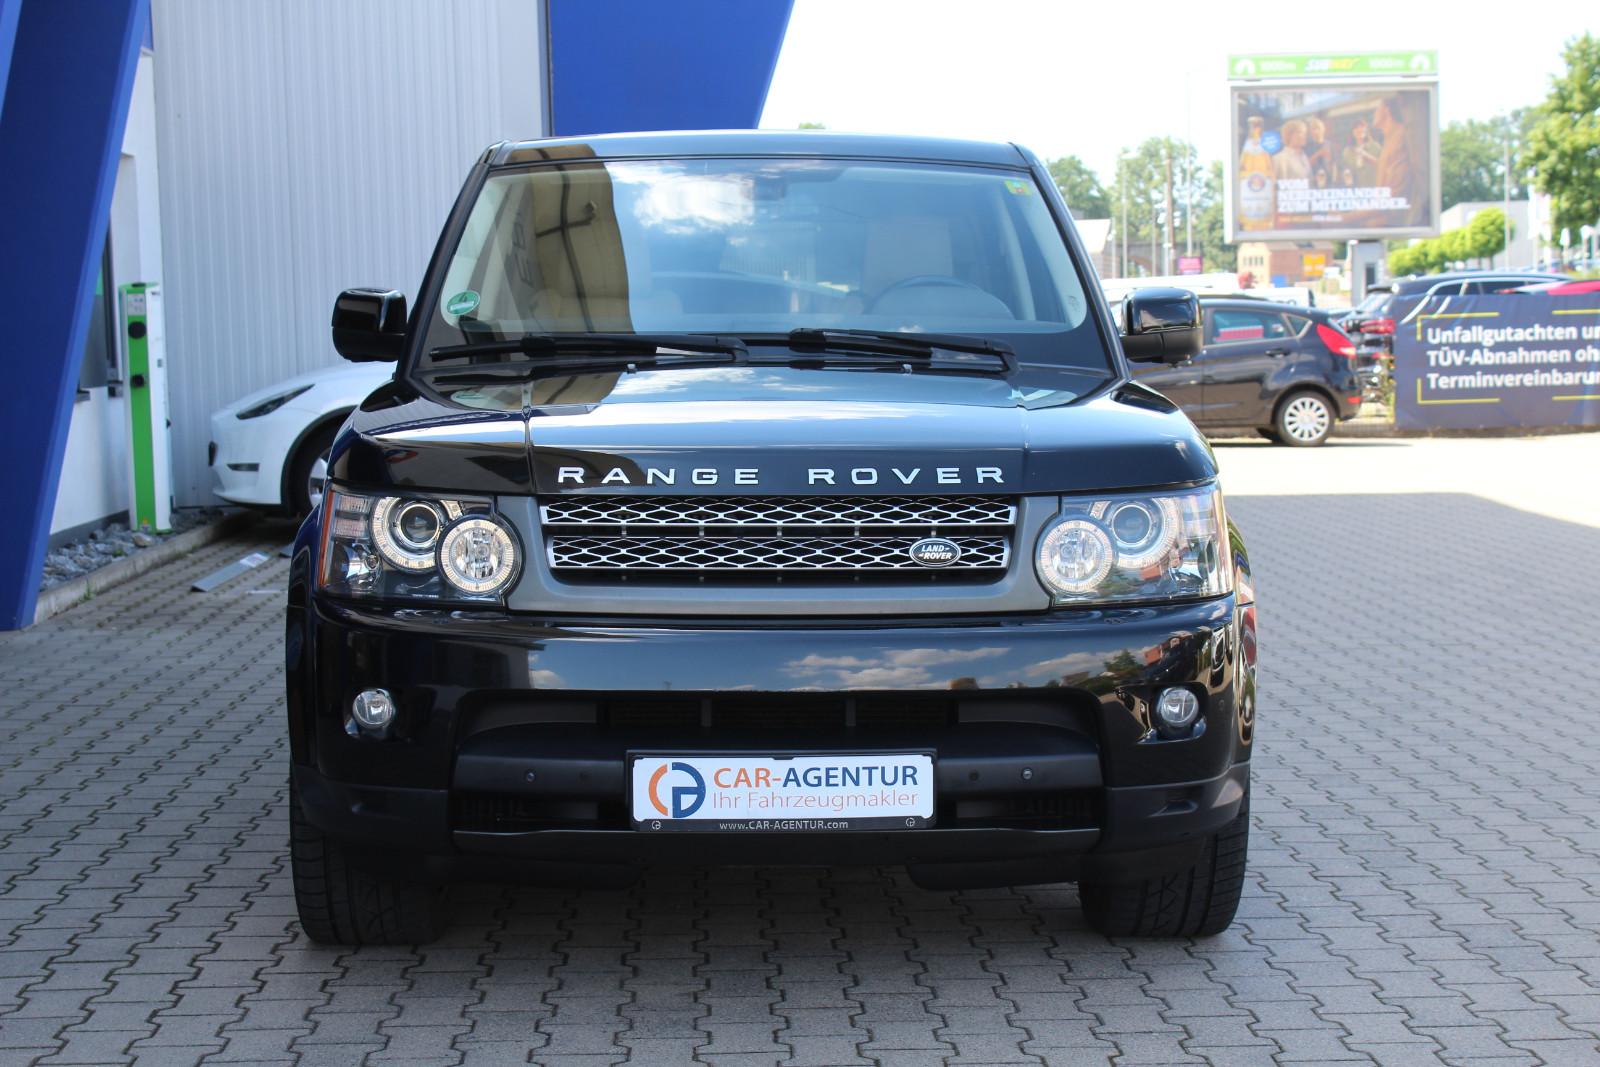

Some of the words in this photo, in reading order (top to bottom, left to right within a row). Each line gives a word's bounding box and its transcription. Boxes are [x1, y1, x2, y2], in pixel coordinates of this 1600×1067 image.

[1277, 178, 1309, 189] VOM
[1277, 187, 1392, 201] NEBENEINANDER
[1277, 200, 1309, 213] ZUM
[1427, 324, 1578, 347] Unfallgutachten
[1426, 346, 1571, 367] TÜV-Abnahmen
[557, 466, 759, 485] RANGE
[807, 466, 1004, 485] ROVER
[713, 765, 919, 788] CAR-AGENTUR
[712, 791, 741, 809] Ihr
[748, 789, 918, 812] Fahrzeugmakler
[719, 819, 849, 830] www.CAR-AGENTUR.com
